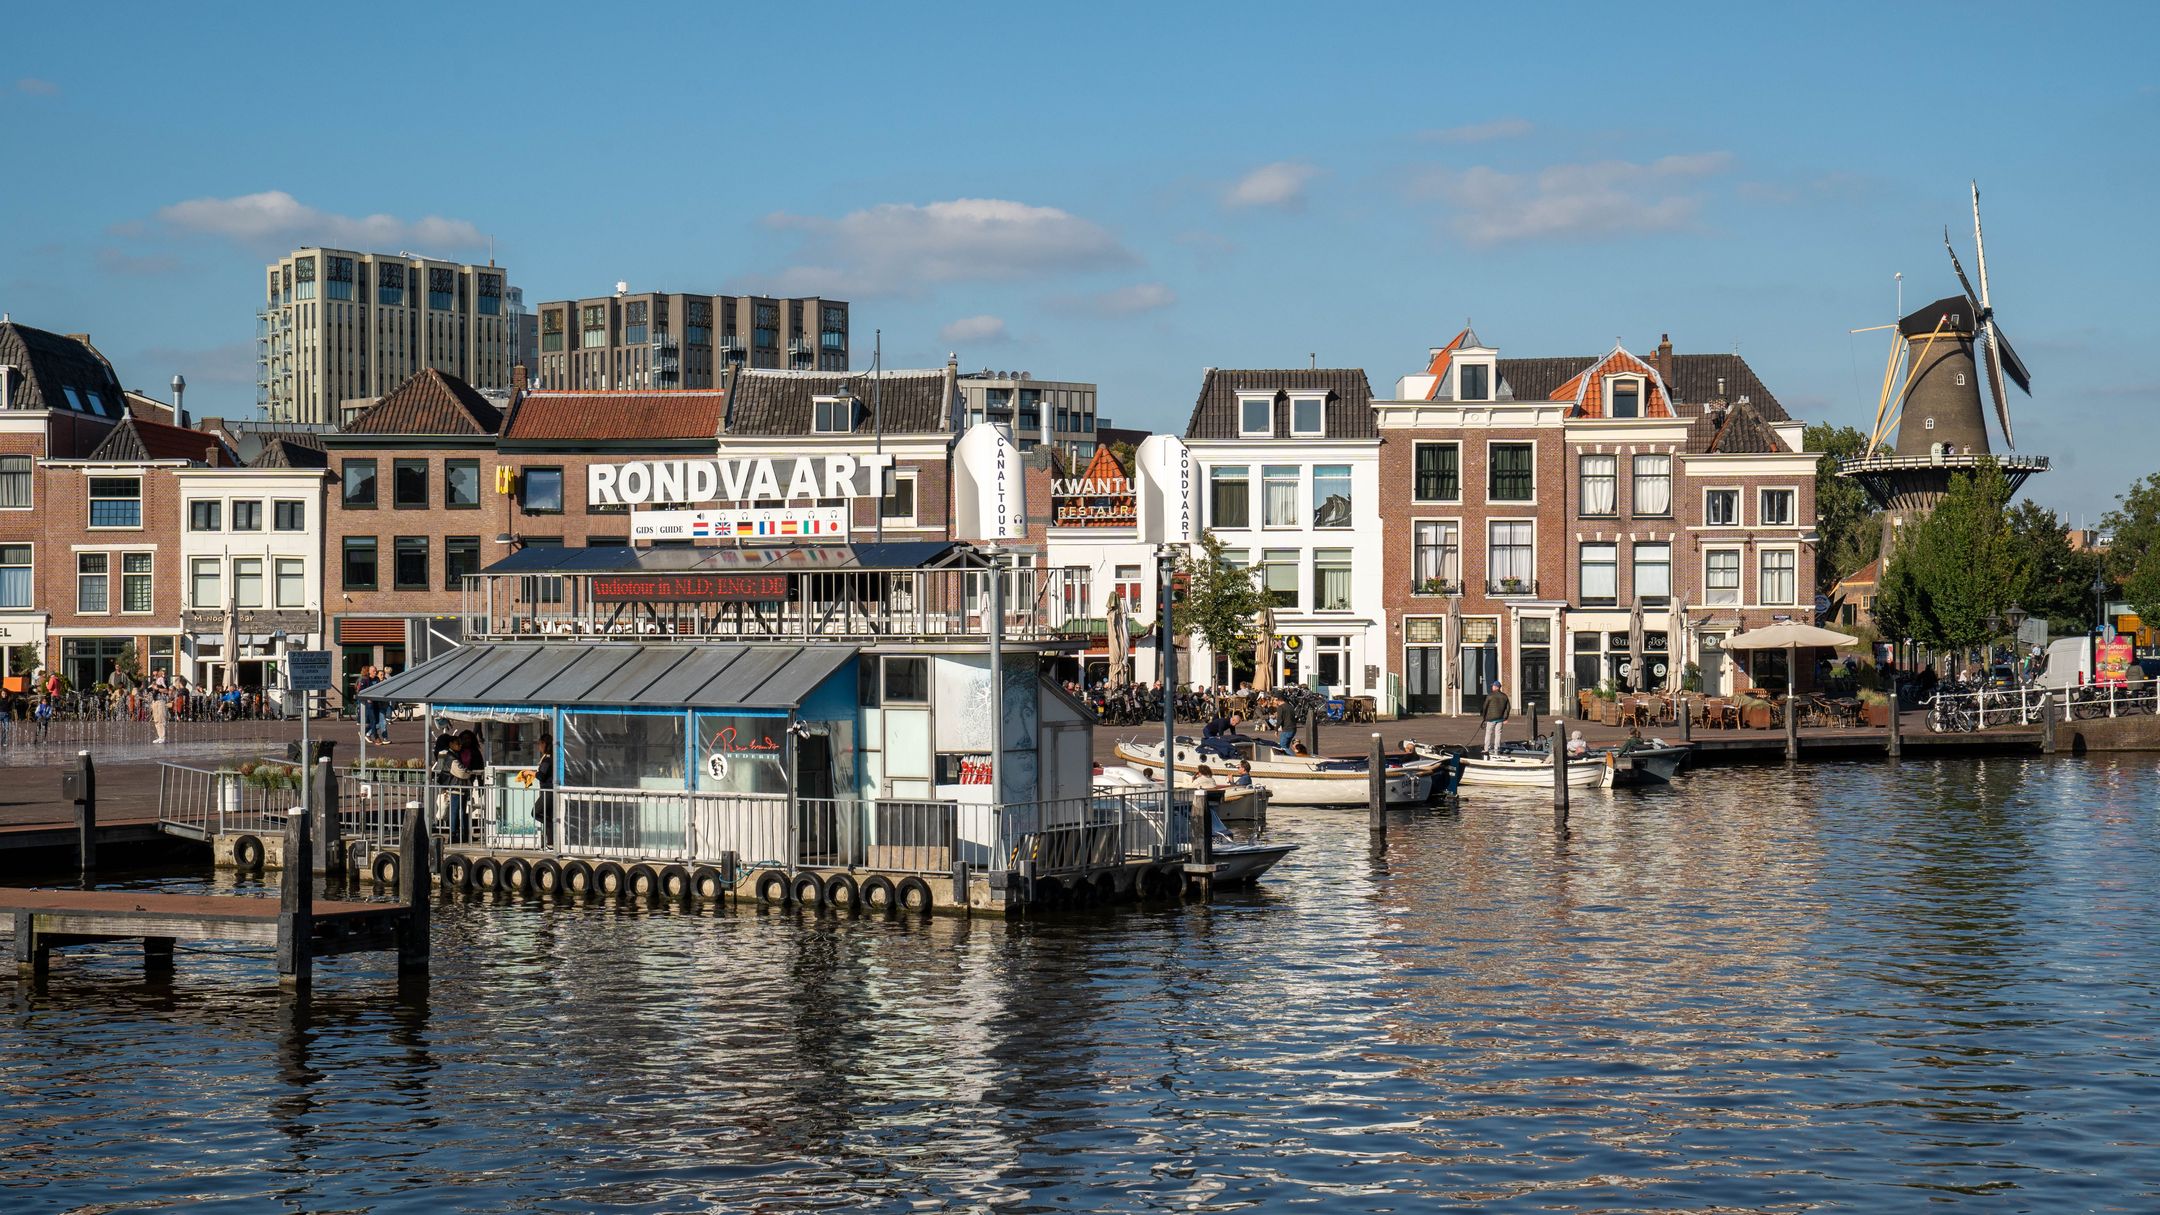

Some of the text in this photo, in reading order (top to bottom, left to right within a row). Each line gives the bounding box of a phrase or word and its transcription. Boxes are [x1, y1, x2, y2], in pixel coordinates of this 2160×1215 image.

[588, 454, 892, 505] RONDVAART
[997, 437, 1006, 536] CANALTOUR
[1181, 449, 1189, 540] RONDVAART
[635, 525, 684, 534] GIDS GUIDE
[659, 577, 671, 593] in
